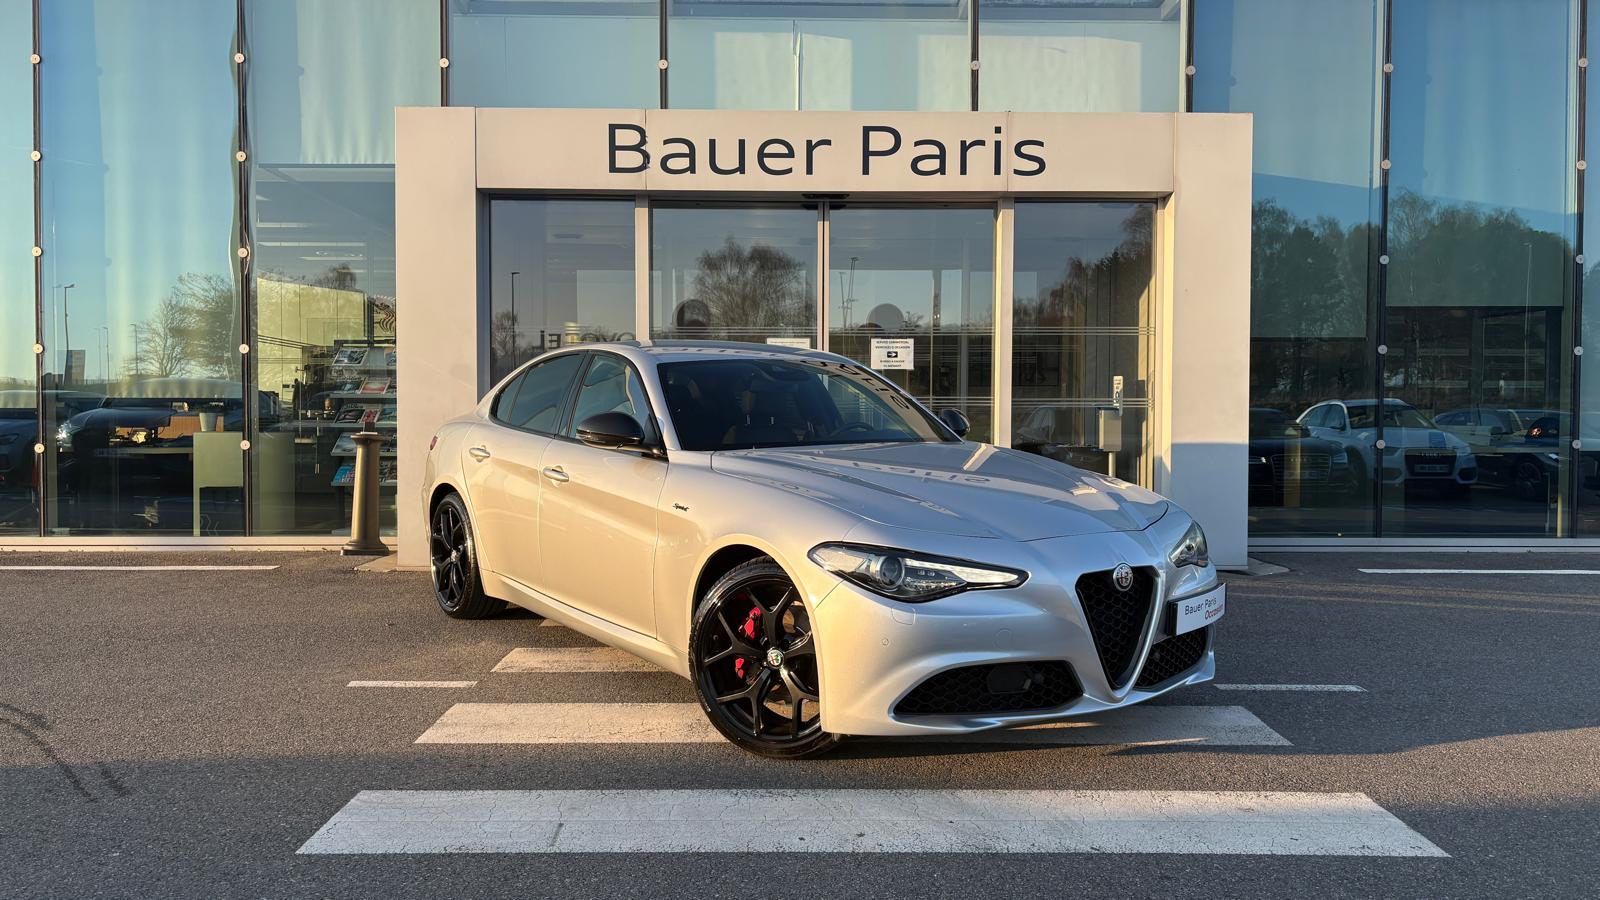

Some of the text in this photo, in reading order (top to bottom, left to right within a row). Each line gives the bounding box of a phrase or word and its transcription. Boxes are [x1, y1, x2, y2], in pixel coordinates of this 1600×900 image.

[608, 123, 1047, 177] Bauer Paris
[1184, 597, 1217, 616] Bauer Paris
